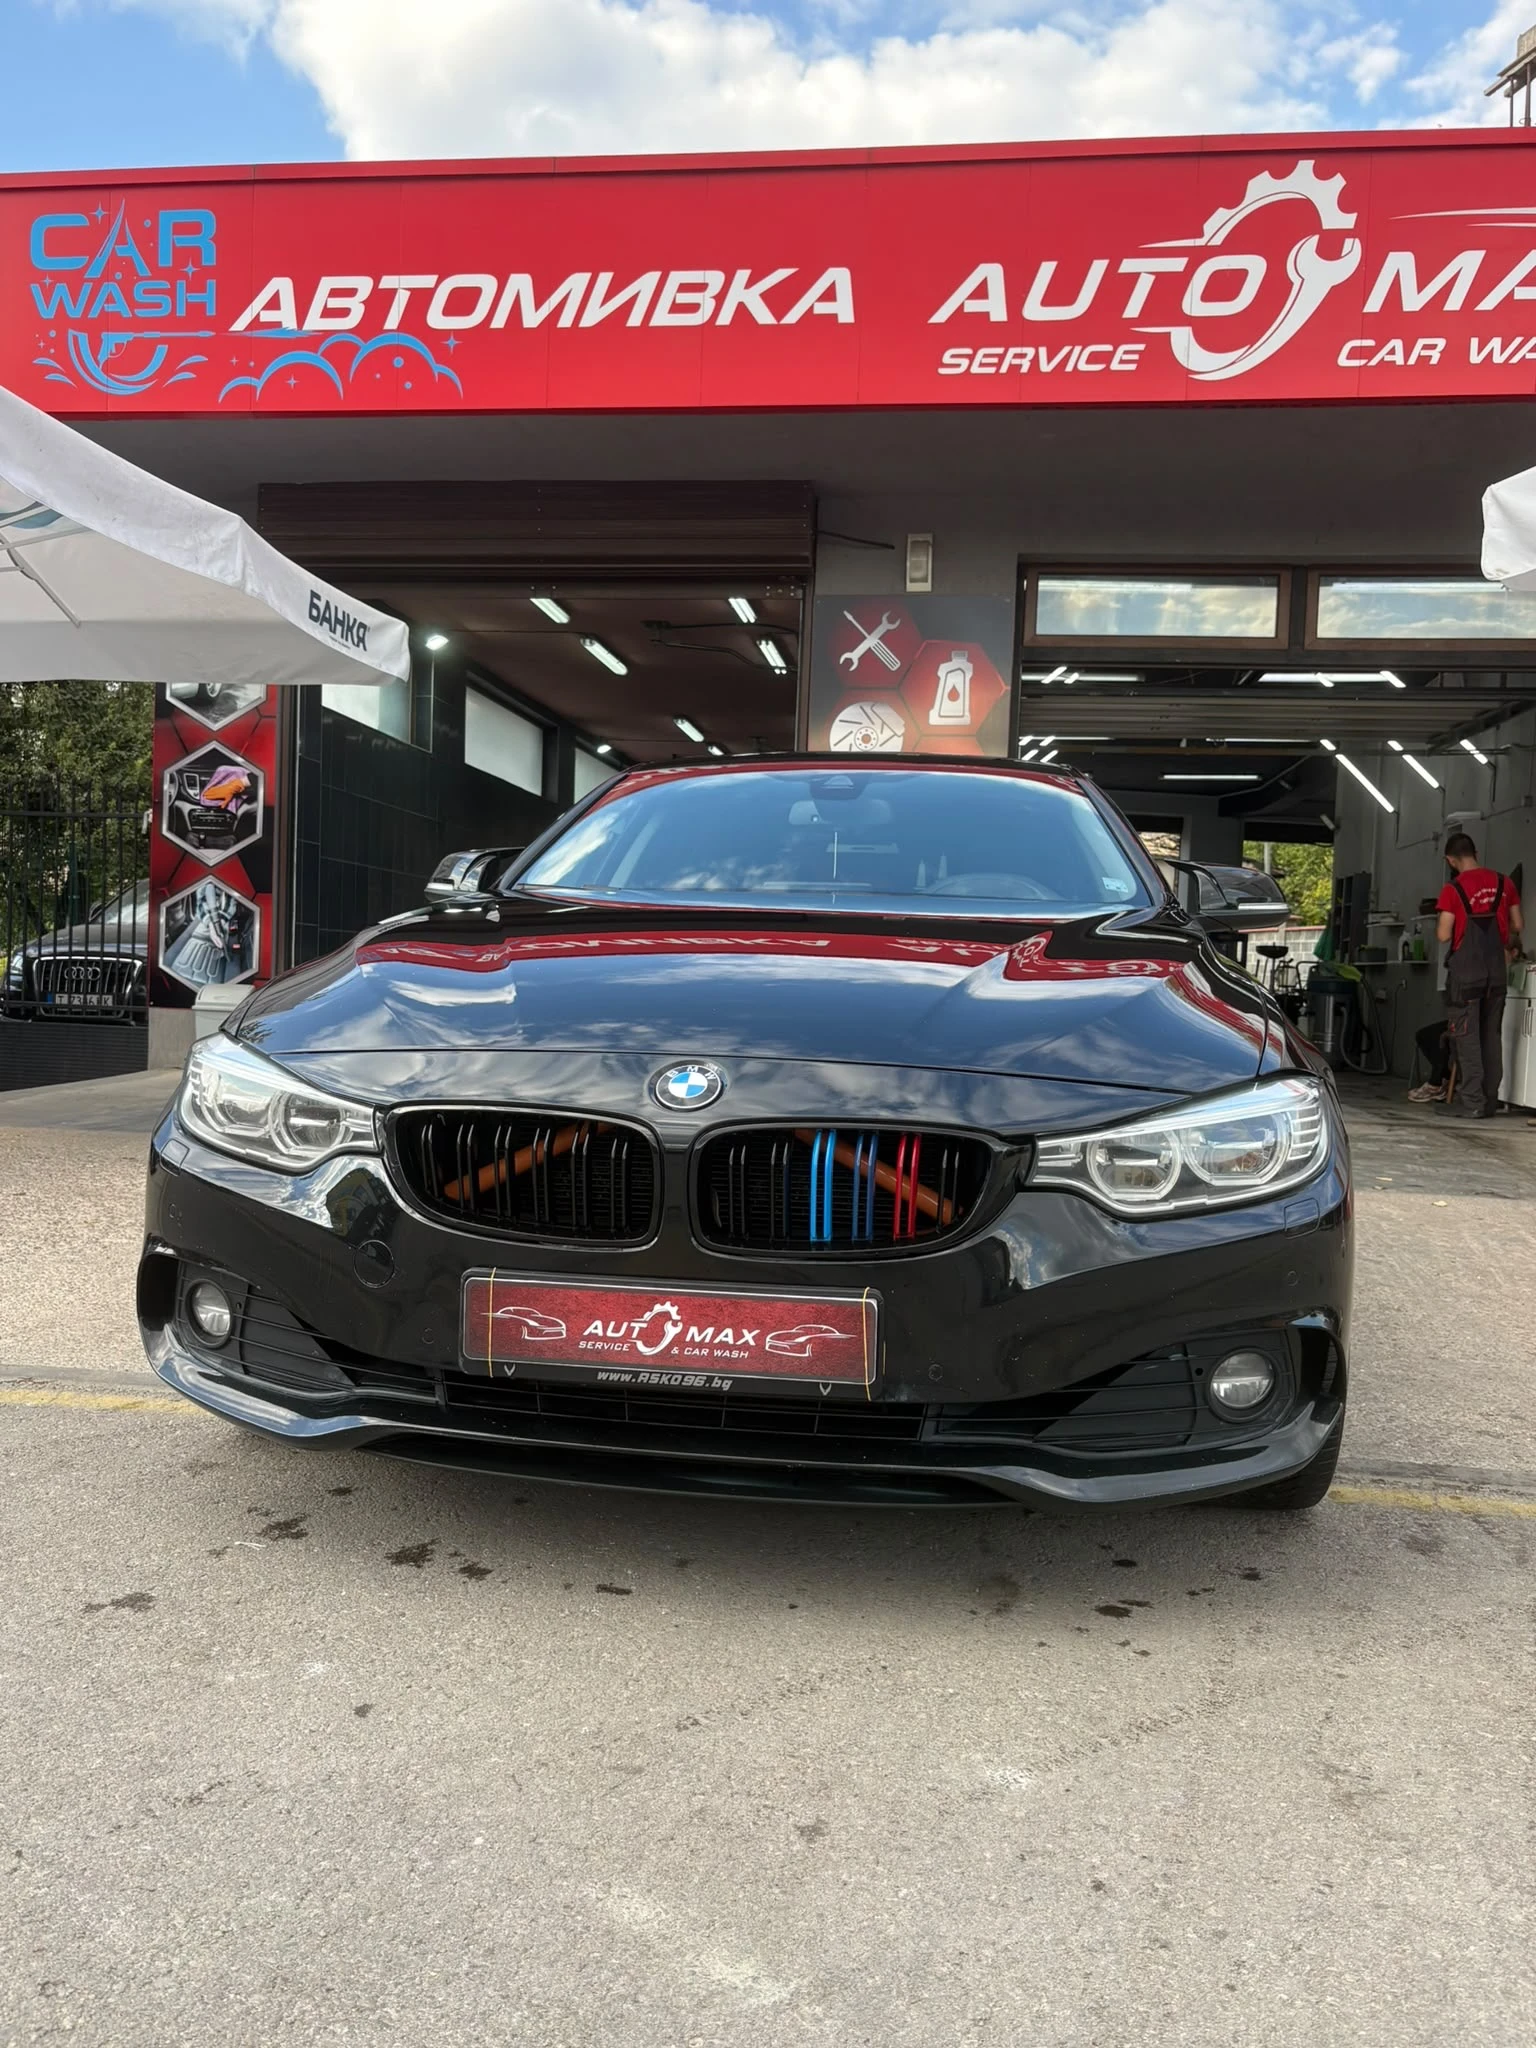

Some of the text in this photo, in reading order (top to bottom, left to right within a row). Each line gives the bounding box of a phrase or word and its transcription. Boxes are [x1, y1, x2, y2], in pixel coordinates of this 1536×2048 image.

[30, 198, 216, 278] CAR
[30, 279, 216, 319] WASH
[228, 267, 855, 331] АВТОМИВКА
[928, 254, 1267, 323] AUTO
[938, 343, 1146, 375] SERVICE
[1337, 337, 1447, 367] CAR
[308, 589, 368, 651] БАНКЯ
[666, 1065, 717, 1080] BMW
[578, 1340, 749, 1359] SERVICE & CAR WASH
[685, 1326, 760, 1346] MAX
